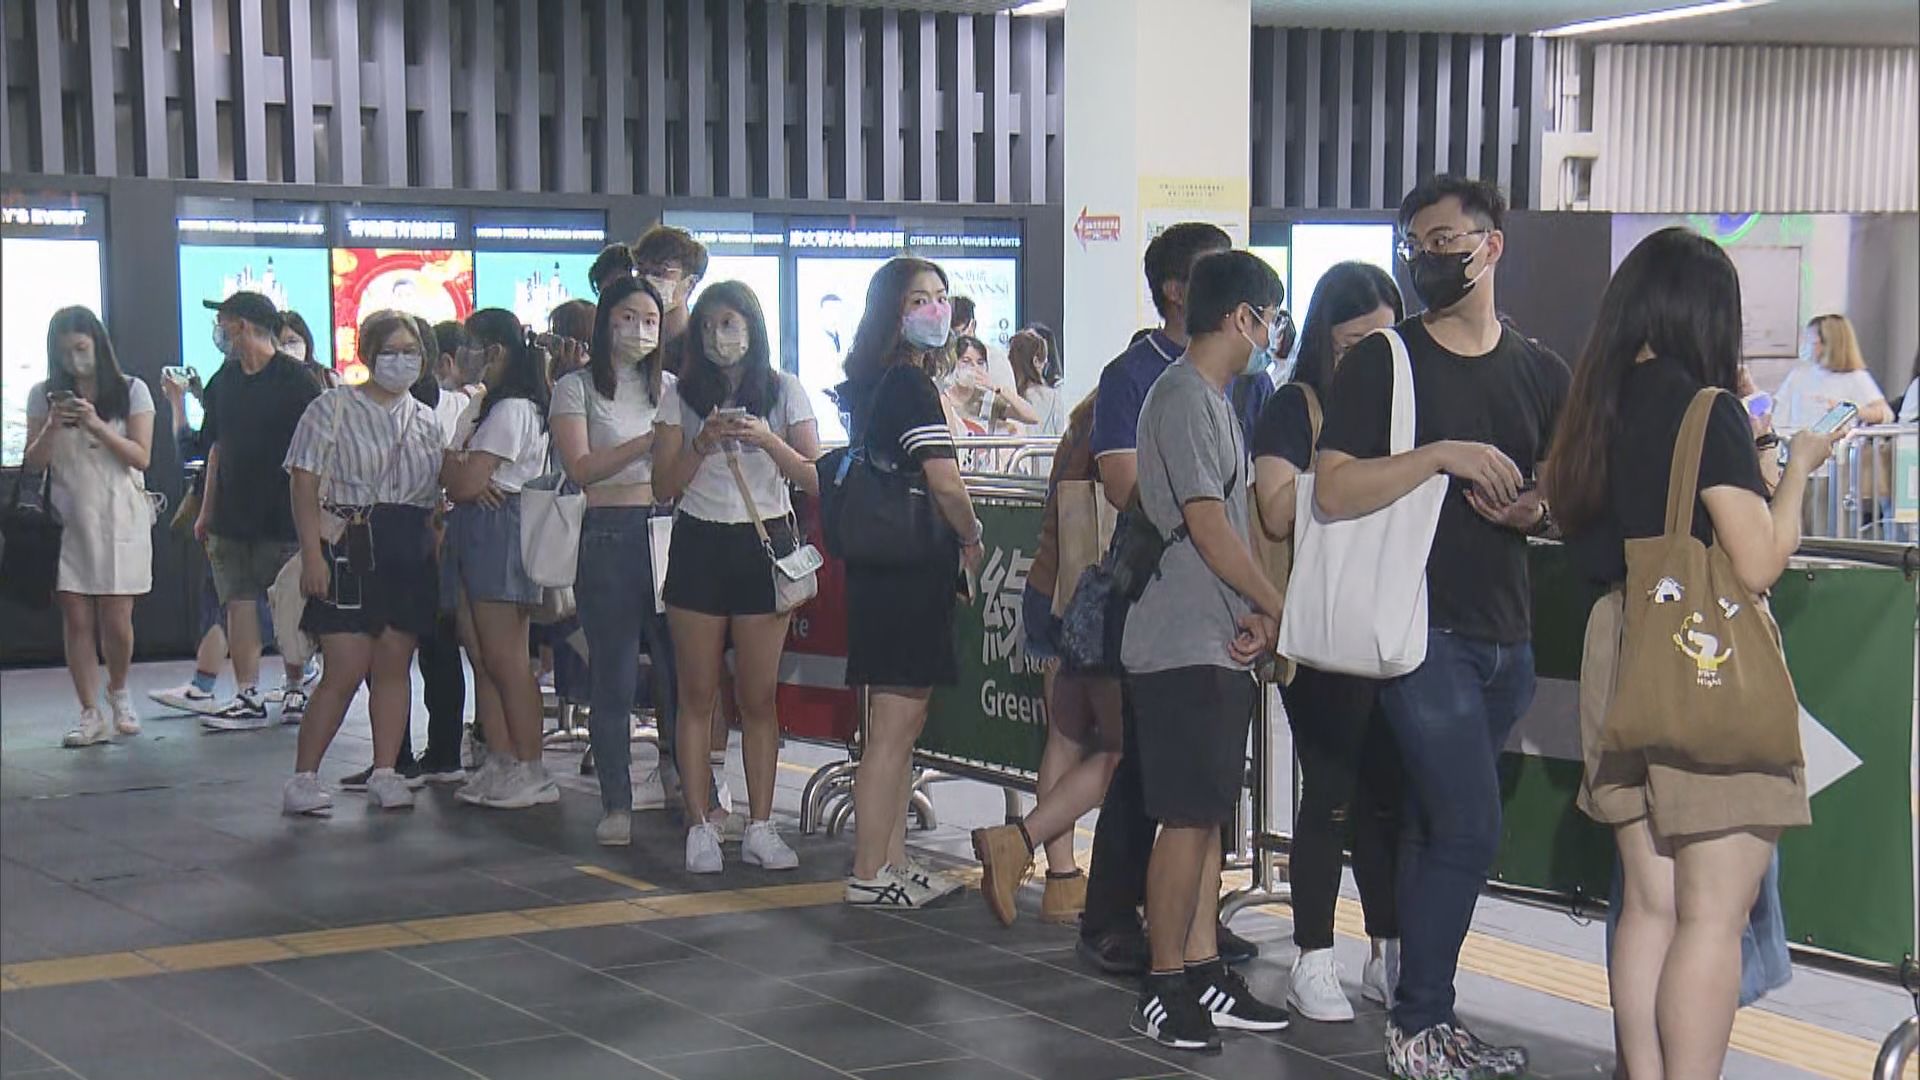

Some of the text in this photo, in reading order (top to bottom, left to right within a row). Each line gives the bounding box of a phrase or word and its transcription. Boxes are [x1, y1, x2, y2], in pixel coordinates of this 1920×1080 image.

[910, 236, 1020, 248] OTHER LCSD VENUES EVENTS
[980, 546, 1040, 674] 綠
[981, 679, 1047, 726] Green
